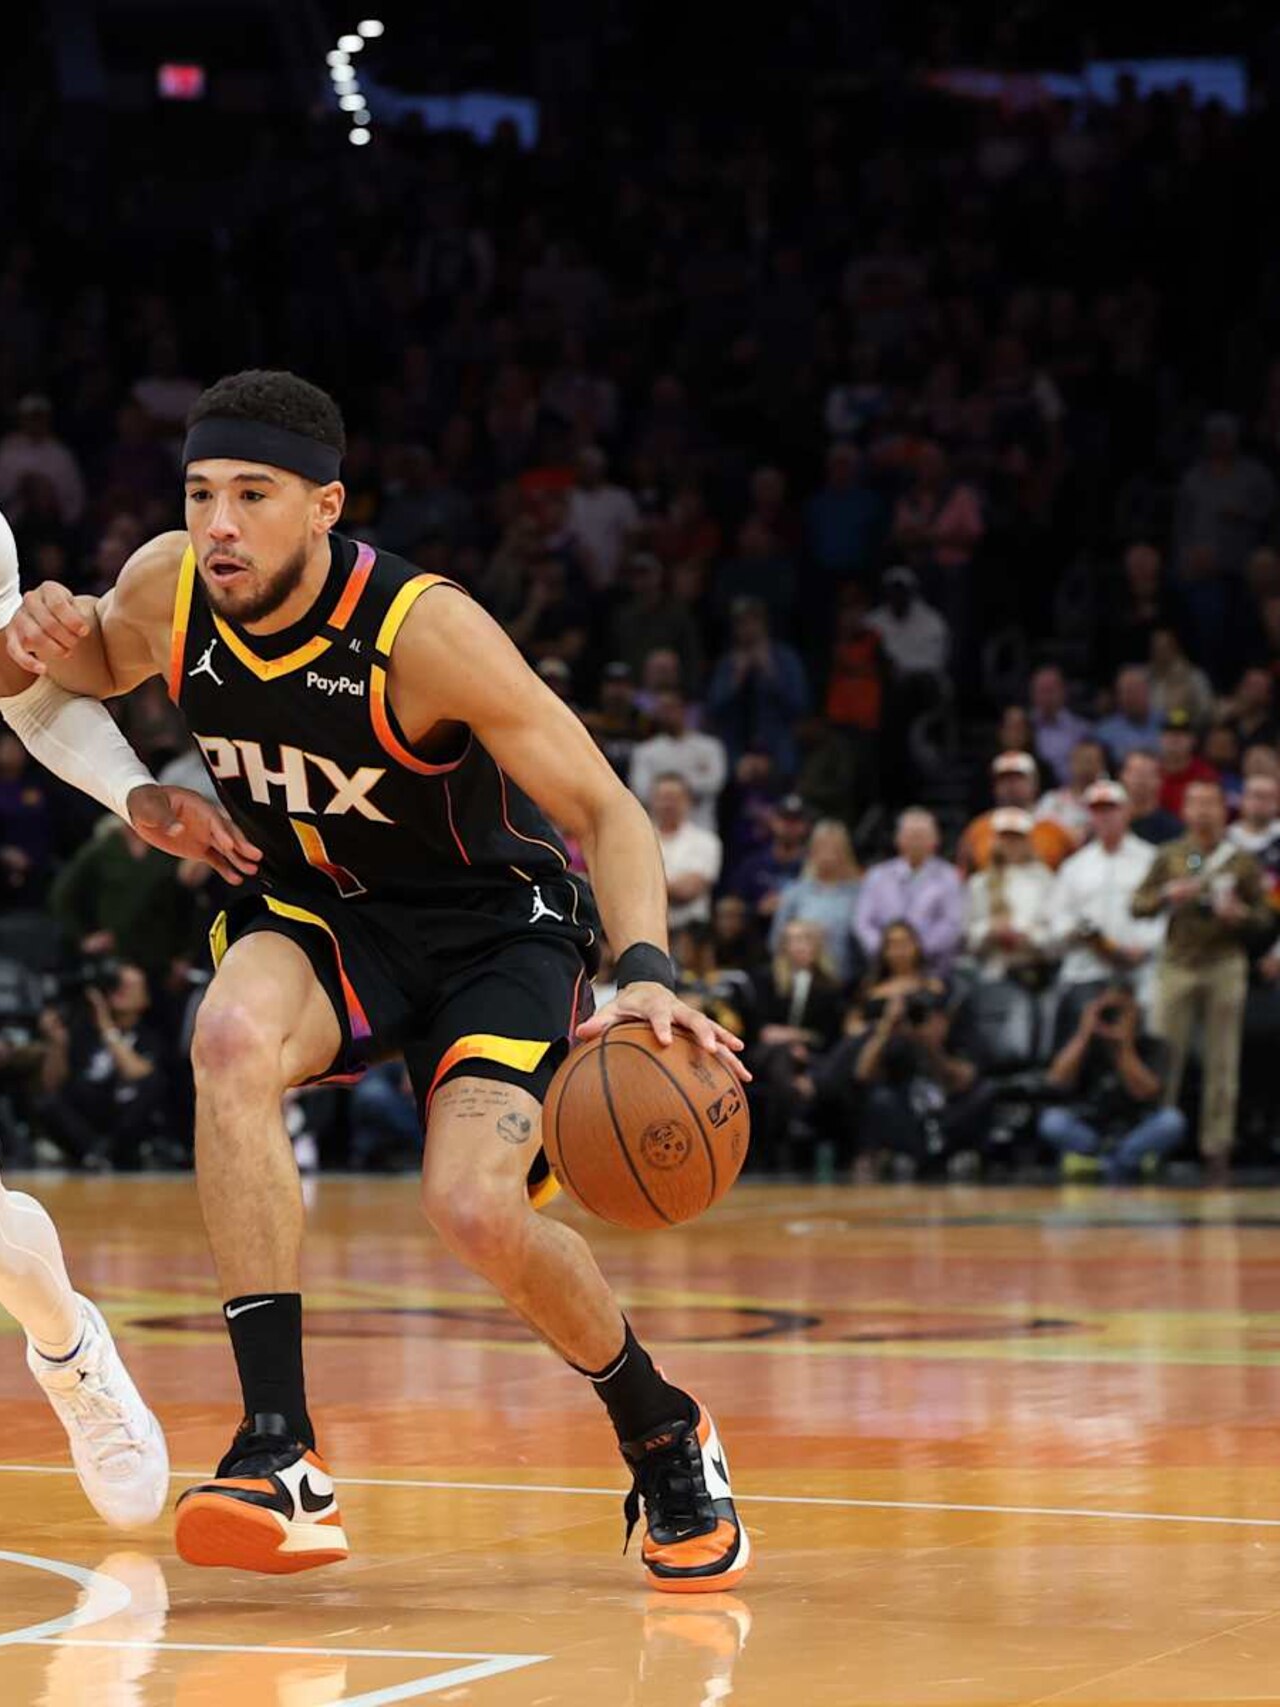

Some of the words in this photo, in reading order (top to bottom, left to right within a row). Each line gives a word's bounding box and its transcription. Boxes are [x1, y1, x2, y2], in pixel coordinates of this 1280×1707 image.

[306, 671, 364, 696] PayPal
[192, 731, 395, 824] PHX
[289, 817, 367, 899] 1
